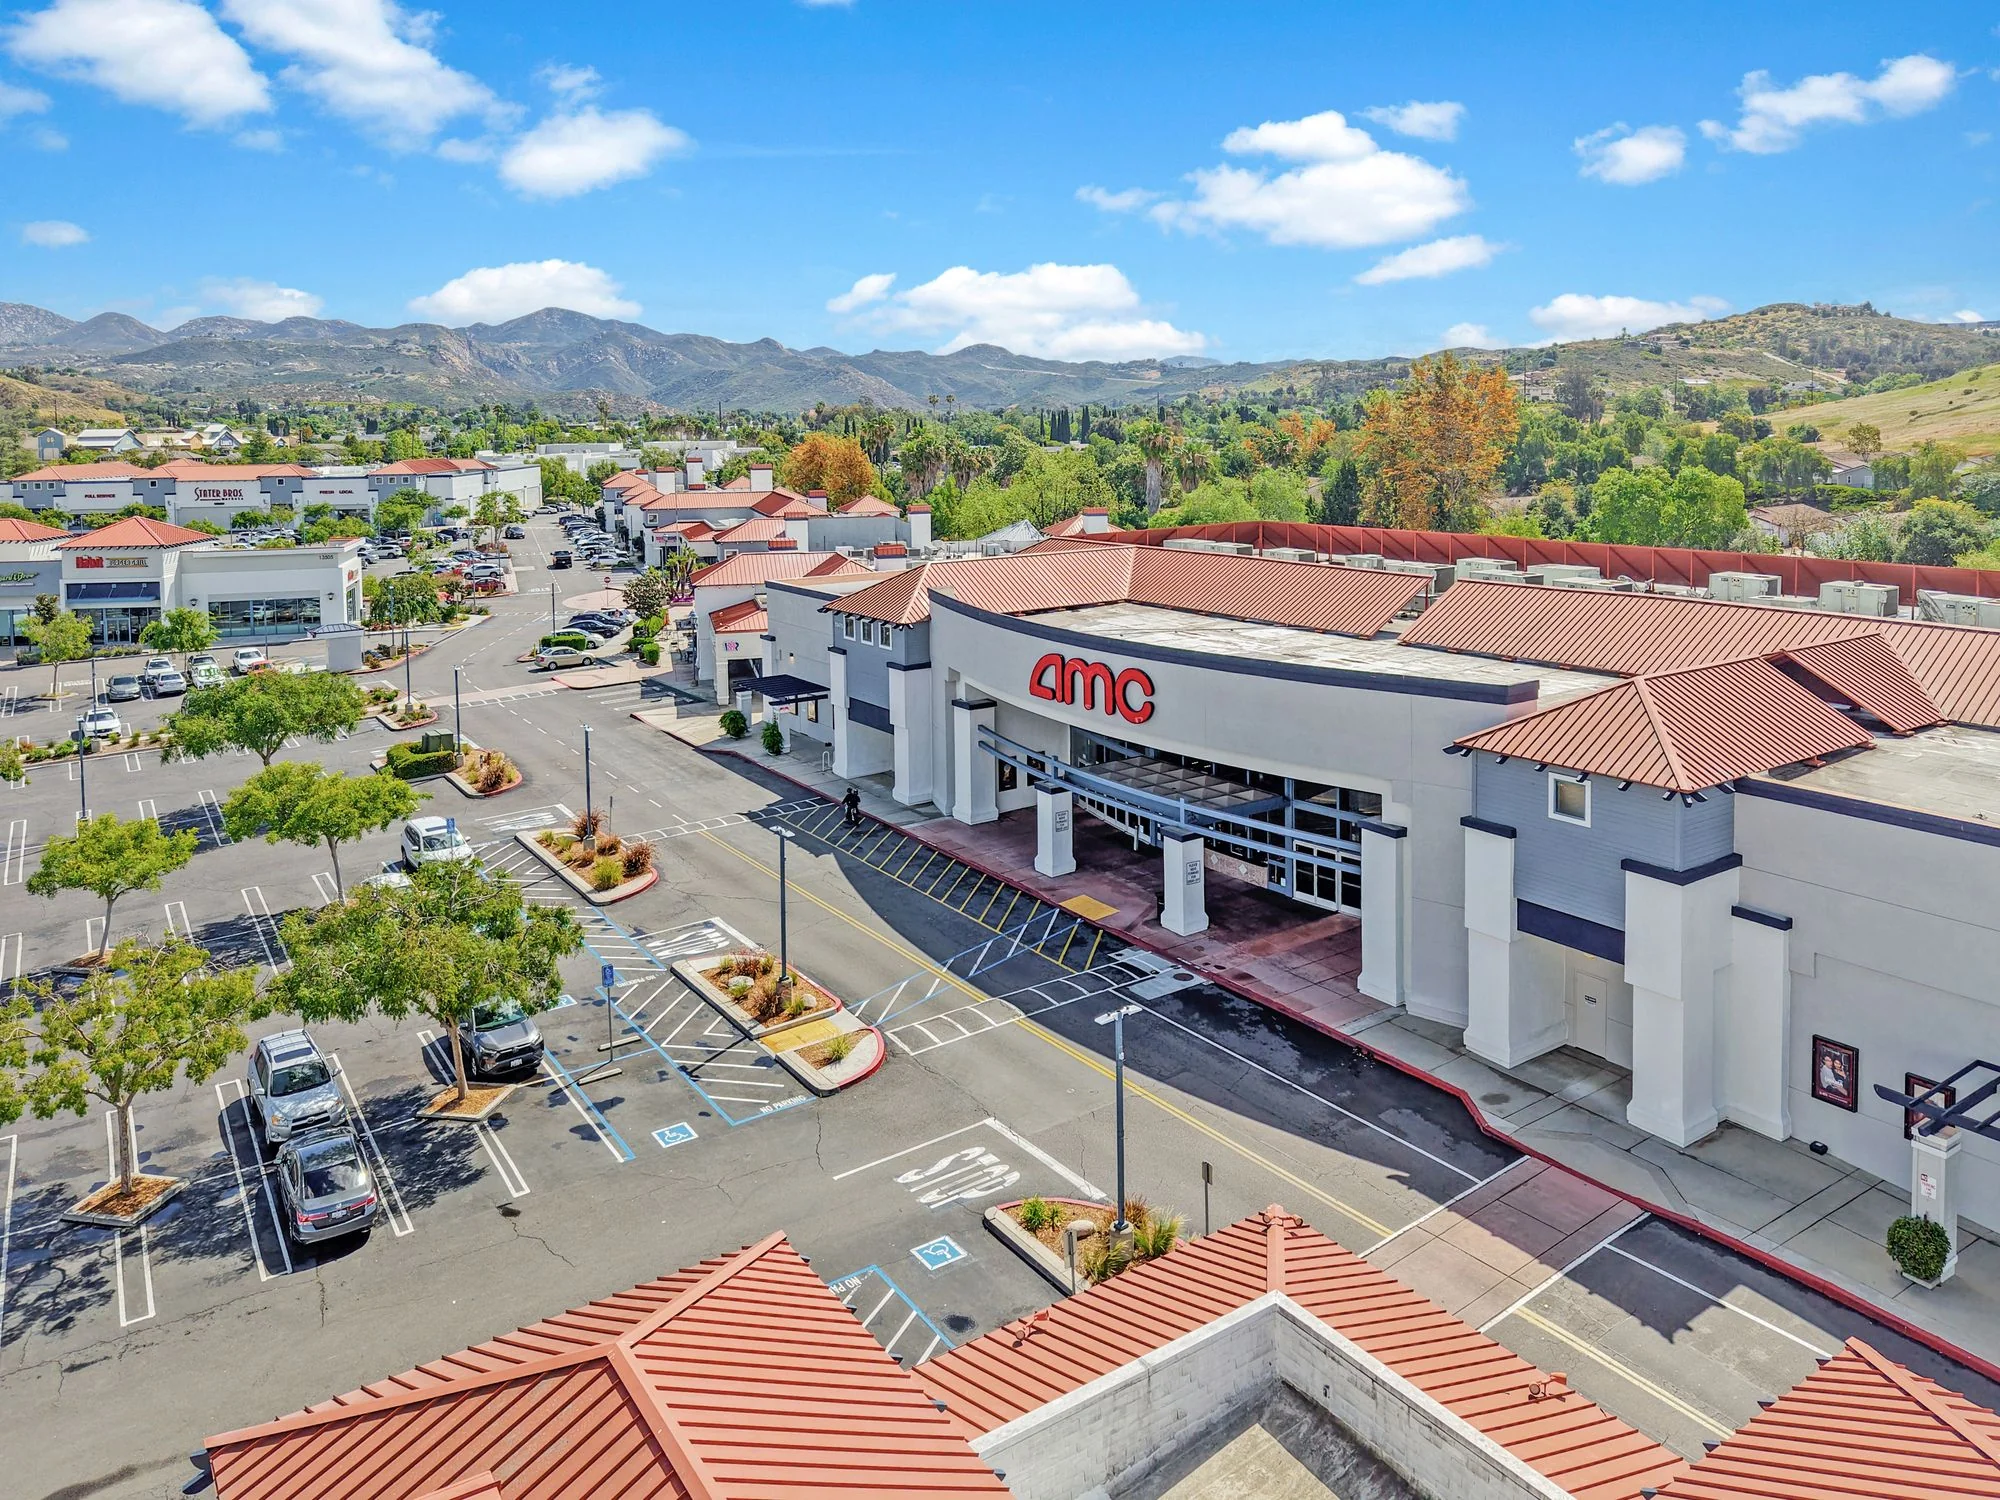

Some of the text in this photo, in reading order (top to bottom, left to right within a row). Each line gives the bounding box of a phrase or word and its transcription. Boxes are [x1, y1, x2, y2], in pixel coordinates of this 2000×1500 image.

[760, 1094, 807, 1113] NO PARKING
[893, 1146, 1021, 1209] STOP
[845, 1276, 862, 1288] NO
